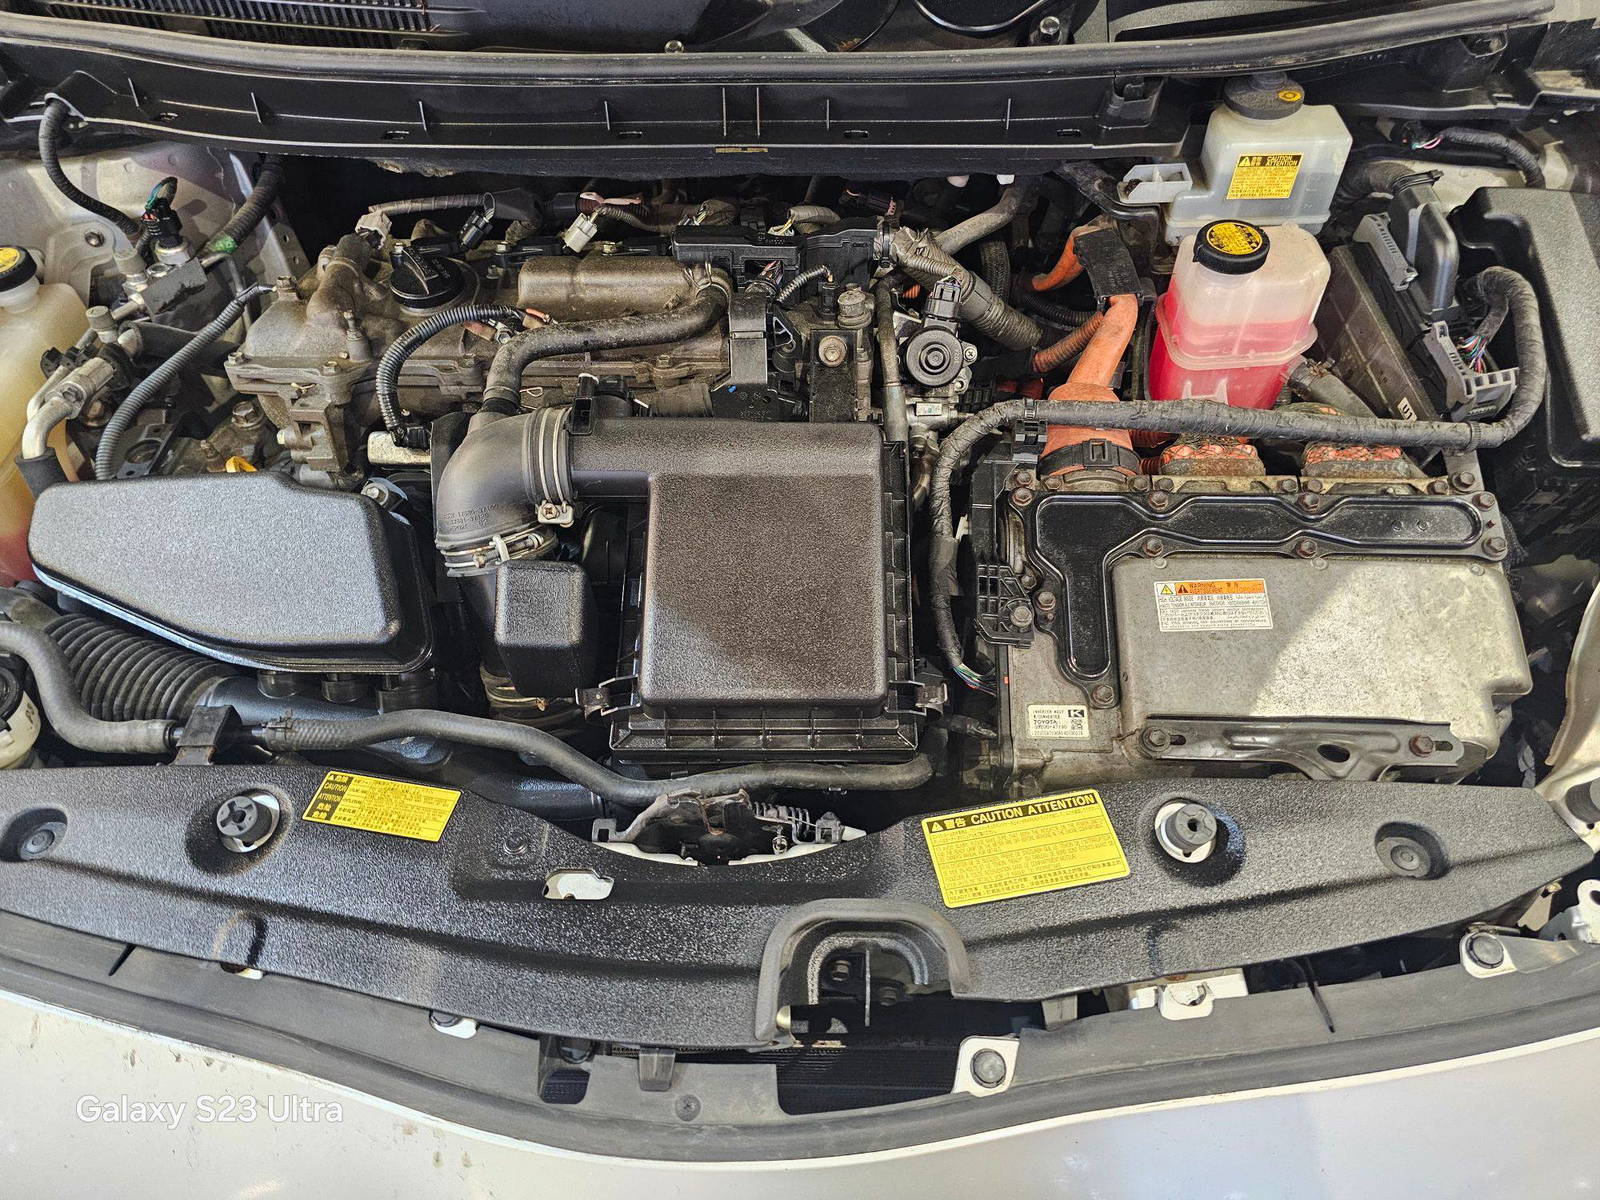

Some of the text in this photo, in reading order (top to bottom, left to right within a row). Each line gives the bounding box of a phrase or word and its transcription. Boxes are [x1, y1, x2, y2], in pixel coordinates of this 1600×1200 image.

[324, 782, 349, 792] CAUTION
[970, 807, 1023, 825] CAUTION
[1028, 794, 1095, 815] ATTENTION
